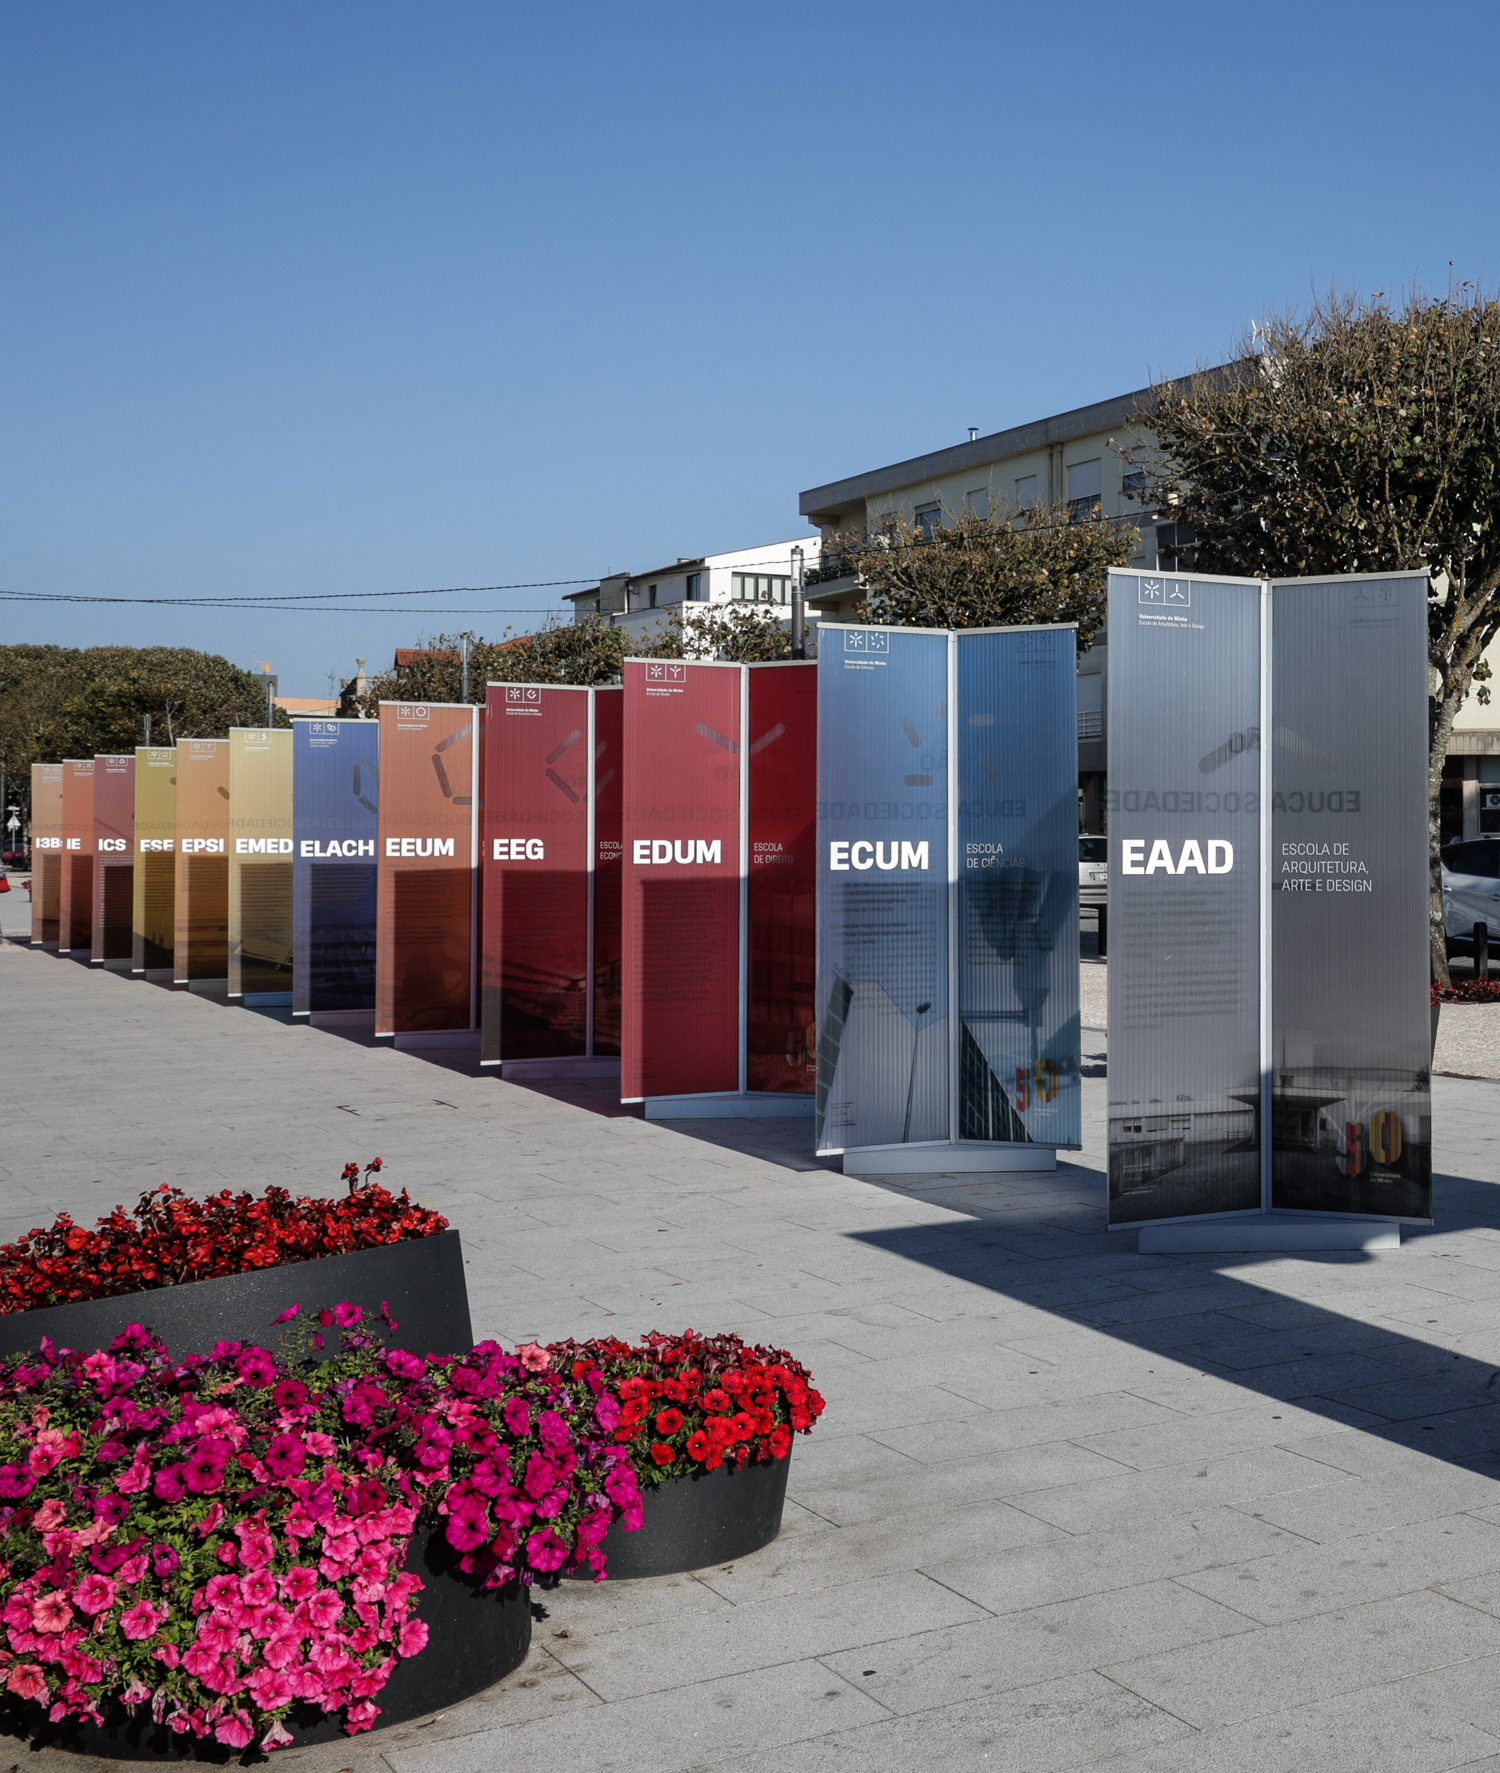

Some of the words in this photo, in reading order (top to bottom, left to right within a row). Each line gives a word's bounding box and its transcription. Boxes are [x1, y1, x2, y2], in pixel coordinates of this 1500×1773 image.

[66, 838, 80, 849] IE
[99, 839, 126, 851] ICS
[140, 839, 174, 852] ESE
[182, 838, 224, 853] EPSI
[236, 838, 293, 853] EMED
[301, 840, 374, 857] ELACH
[385, 838, 454, 856] EEUM
[494, 839, 544, 860] EEG
[754, 843, 783, 851] ESCOLA
[967, 843, 1003, 853] ESCOLA
[1282, 842, 1329, 856] ESCOLA
[1333, 843, 1350, 856] DE
[633, 839, 721, 865] EDUM
[754, 855, 763, 863] DE
[766, 855, 793, 864] DIREITO
[830, 841, 929, 870] ECUM
[1122, 839, 1234, 875] EAAD
[967, 858, 979, 868] DE
[981, 855, 1025, 868] CIÊNCIAS
[1282, 860, 1369, 876] ARQUITETURA,
[1282, 878, 1312, 892] ARTE
[1316, 879, 1322, 892] E
[1326, 879, 1372, 892] DESIGN
[1335, 1109, 1402, 1178] 50
